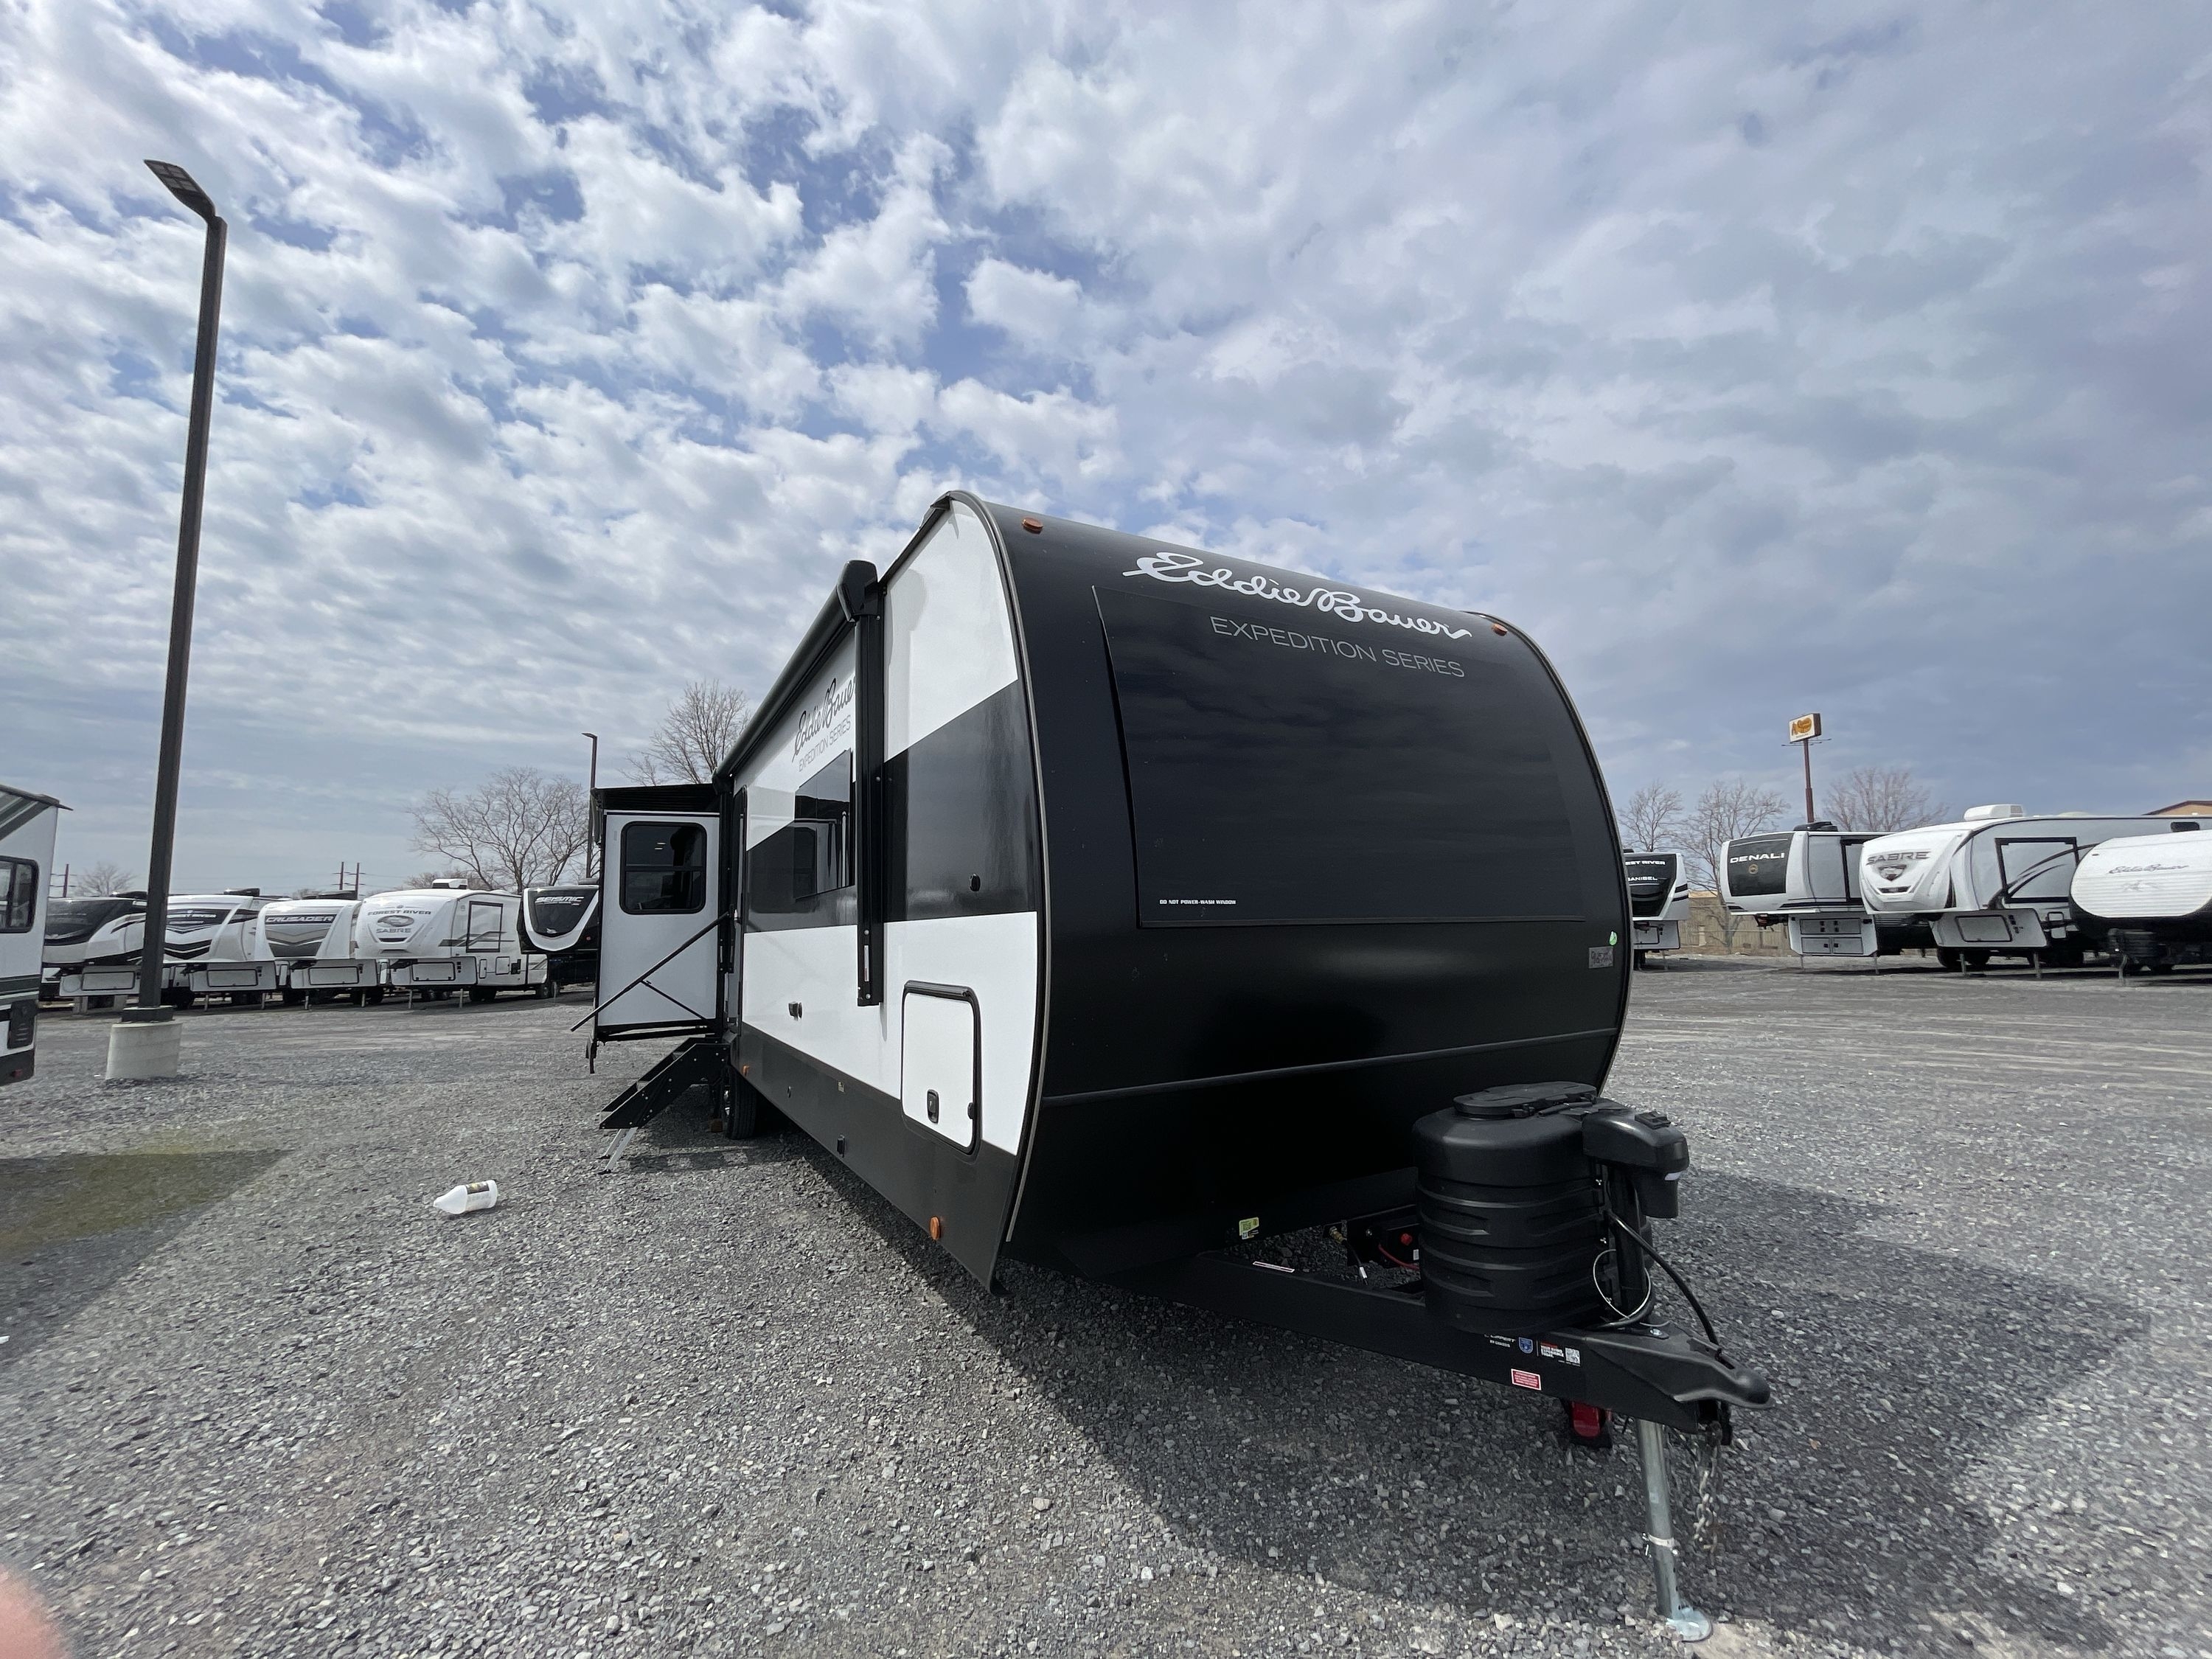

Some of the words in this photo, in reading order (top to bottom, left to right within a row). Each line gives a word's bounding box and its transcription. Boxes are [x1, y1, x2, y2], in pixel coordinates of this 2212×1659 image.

[1122, 552, 1310, 607] Eddie
[1307, 588, 1472, 639] Bauer
[1209, 616, 1377, 661] EXPEDITION
[1382, 650, 1465, 678] SERIES
[792, 706, 823, 763] Eddie
[799, 734, 829, 772] EXPEDITION
[830, 714, 851, 745] SERIES
[1730, 852, 1785, 863] DENALI
[1866, 851, 1931, 866] SABRE
